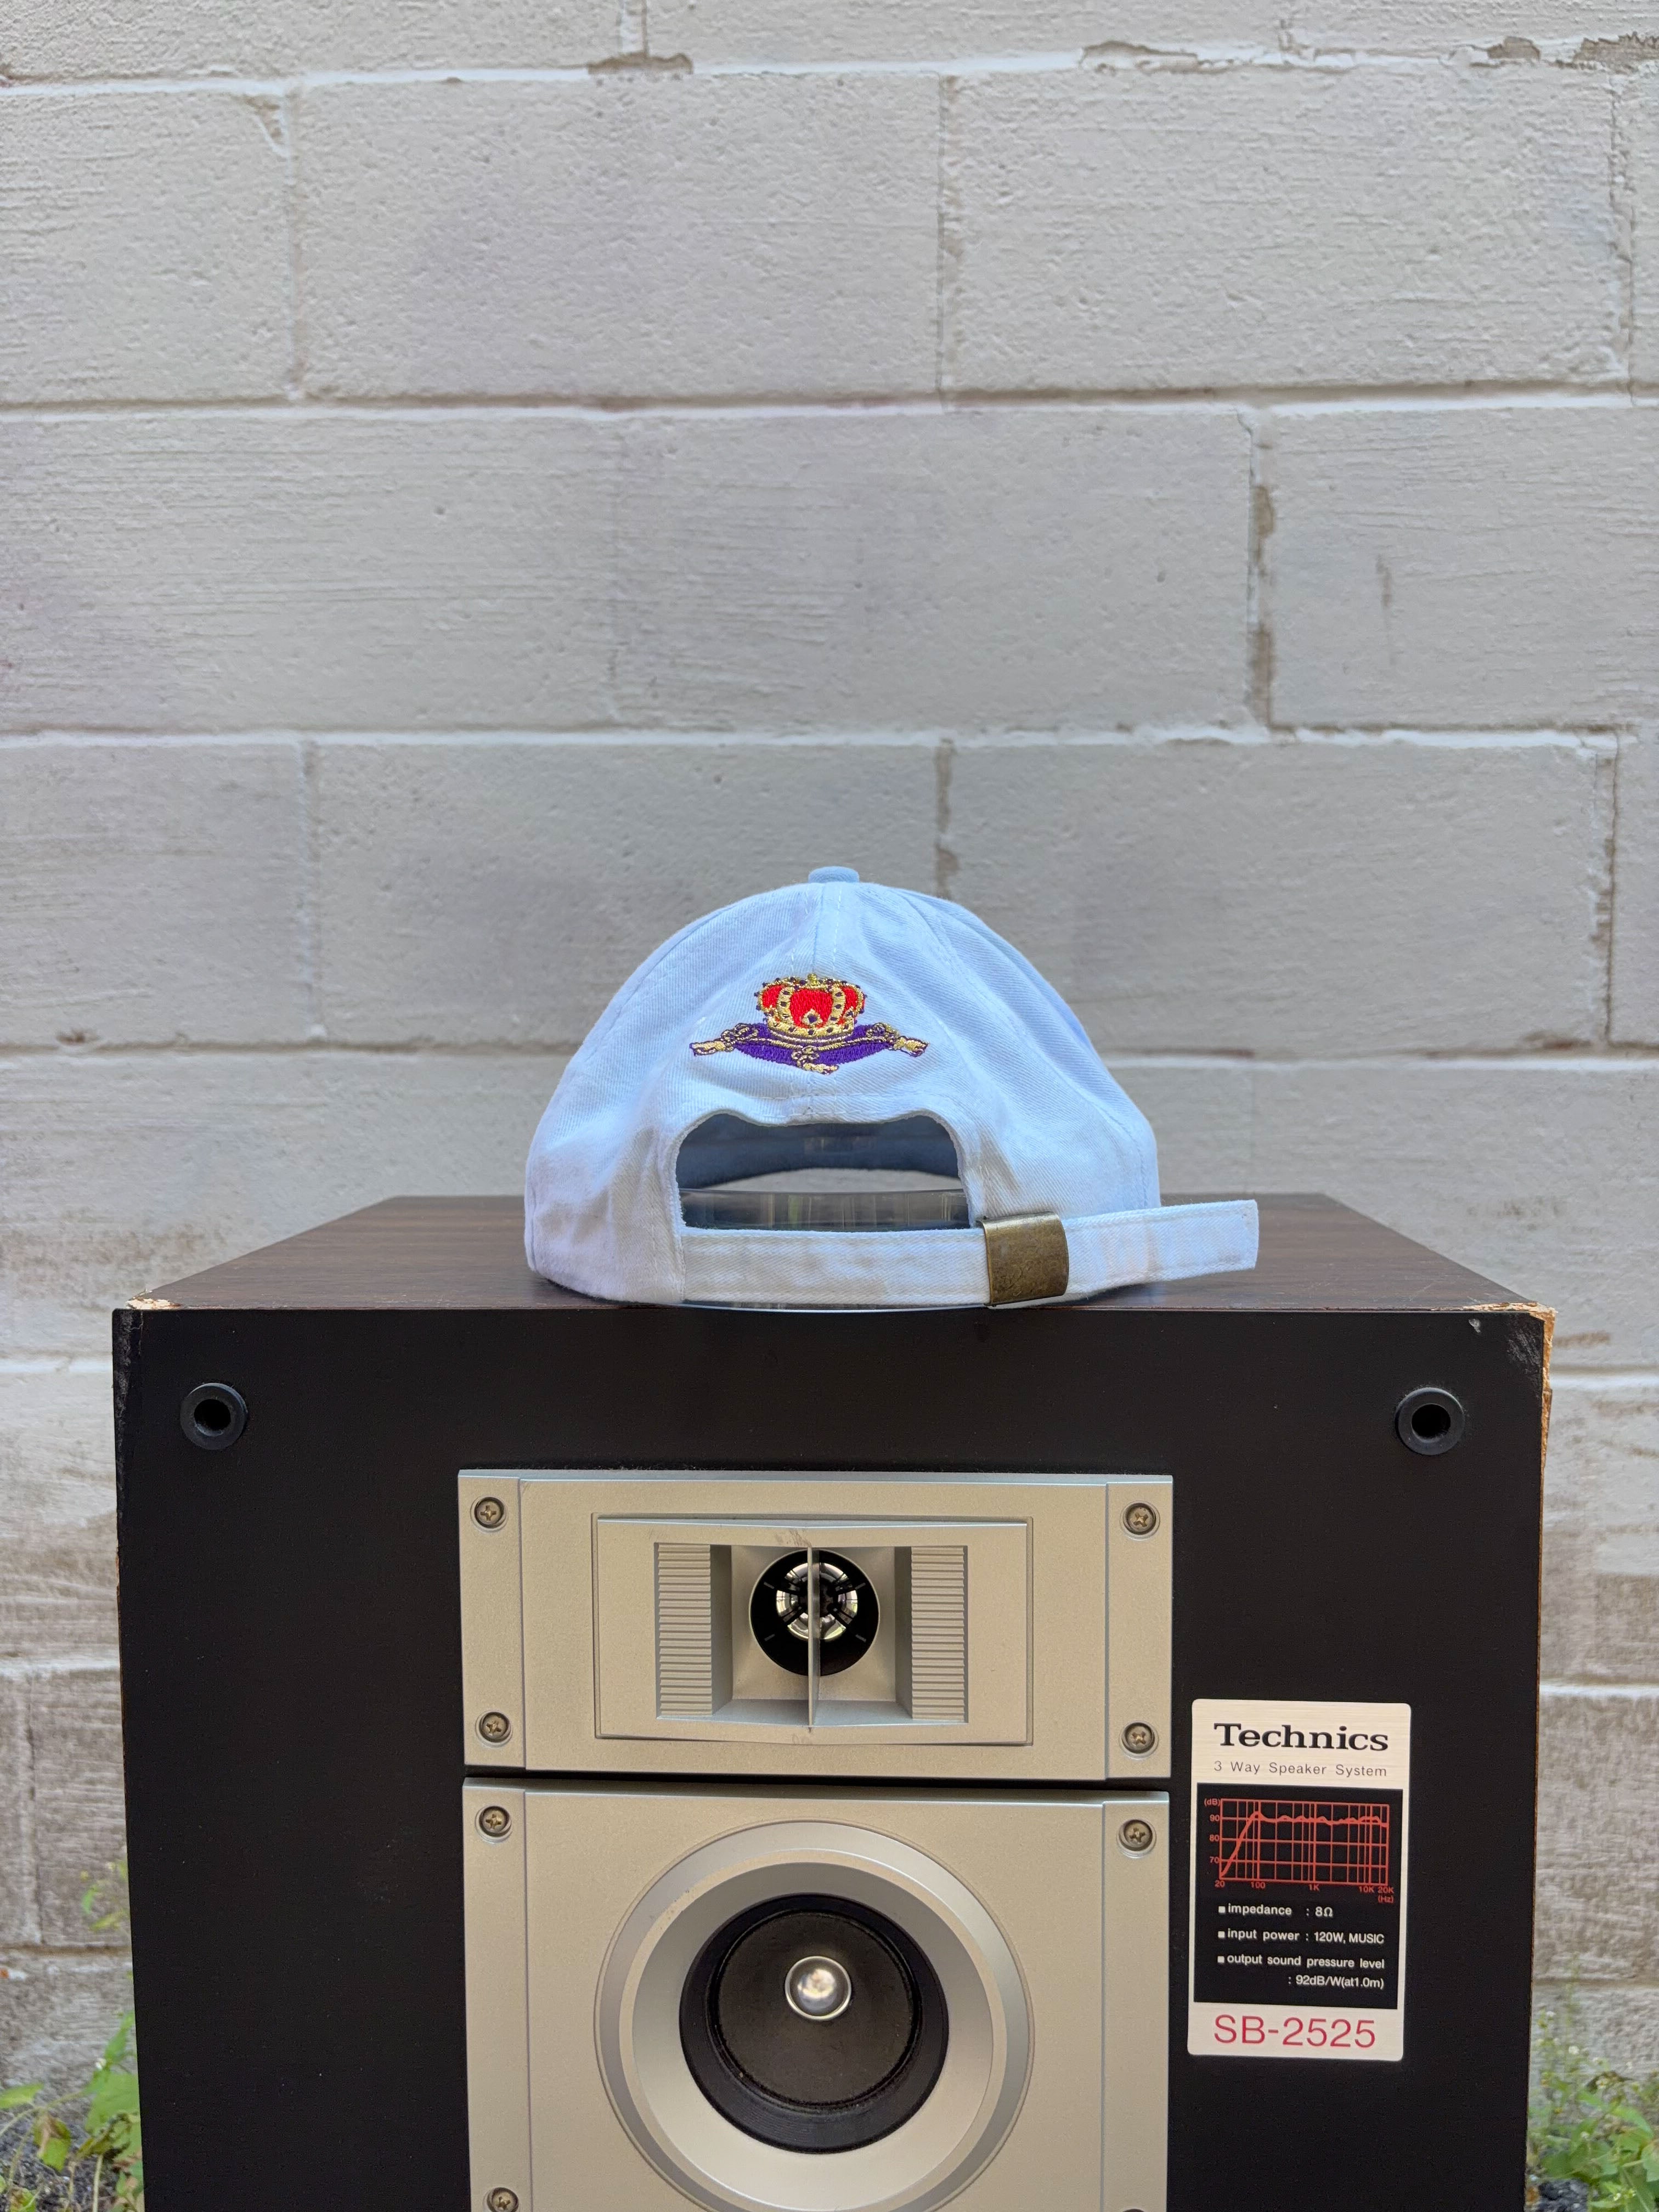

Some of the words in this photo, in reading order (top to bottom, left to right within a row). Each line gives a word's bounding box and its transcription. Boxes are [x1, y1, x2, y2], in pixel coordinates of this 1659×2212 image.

[1214, 1723, 1389, 1751] Technics
[1214, 1760, 1222, 1772] 3
[1231, 1762, 1260, 1774] Way
[1269, 1762, 1327, 1776] Speaker
[1336, 1764, 1387, 1778] System
[1204, 1798, 1221, 1807] (dB)
[1251, 1881, 1266, 1889] 100
[1228, 1903, 1293, 1917] impedance
[1315, 1906, 1334, 1917] 8Ω
[1227, 1928, 1257, 1940] input
[1263, 1931, 1300, 1943] power
[1314, 1931, 1346, 1945] 120W,
[1348, 1932, 1385, 1944] MUSIC
[1227, 1954, 1263, 1966] output
[1267, 1955, 1301, 1966] sound
[1307, 1957, 1355, 1969] pressure
[1360, 1958, 1385, 1969] level
[1214, 2014, 1375, 2048] SB-2525
